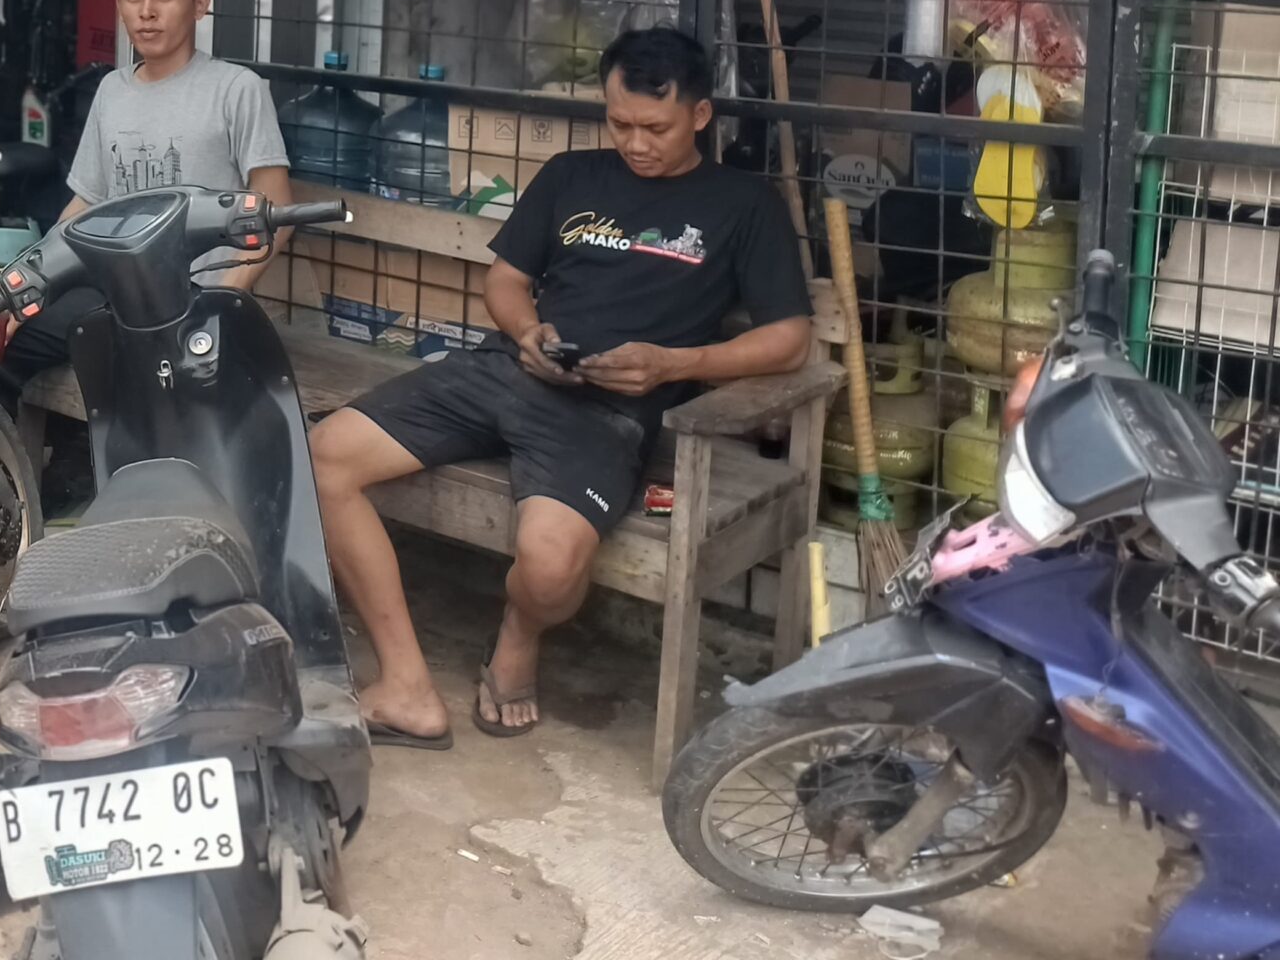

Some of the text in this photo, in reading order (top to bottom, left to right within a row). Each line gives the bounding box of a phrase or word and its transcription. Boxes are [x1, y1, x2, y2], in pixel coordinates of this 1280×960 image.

[560, 211, 624, 246] Golden
[582, 232, 631, 251] MAKO
[2, 800, 21, 843] B
[48, 779, 142, 832] 7742
[61, 851, 106, 868] DASUKI
